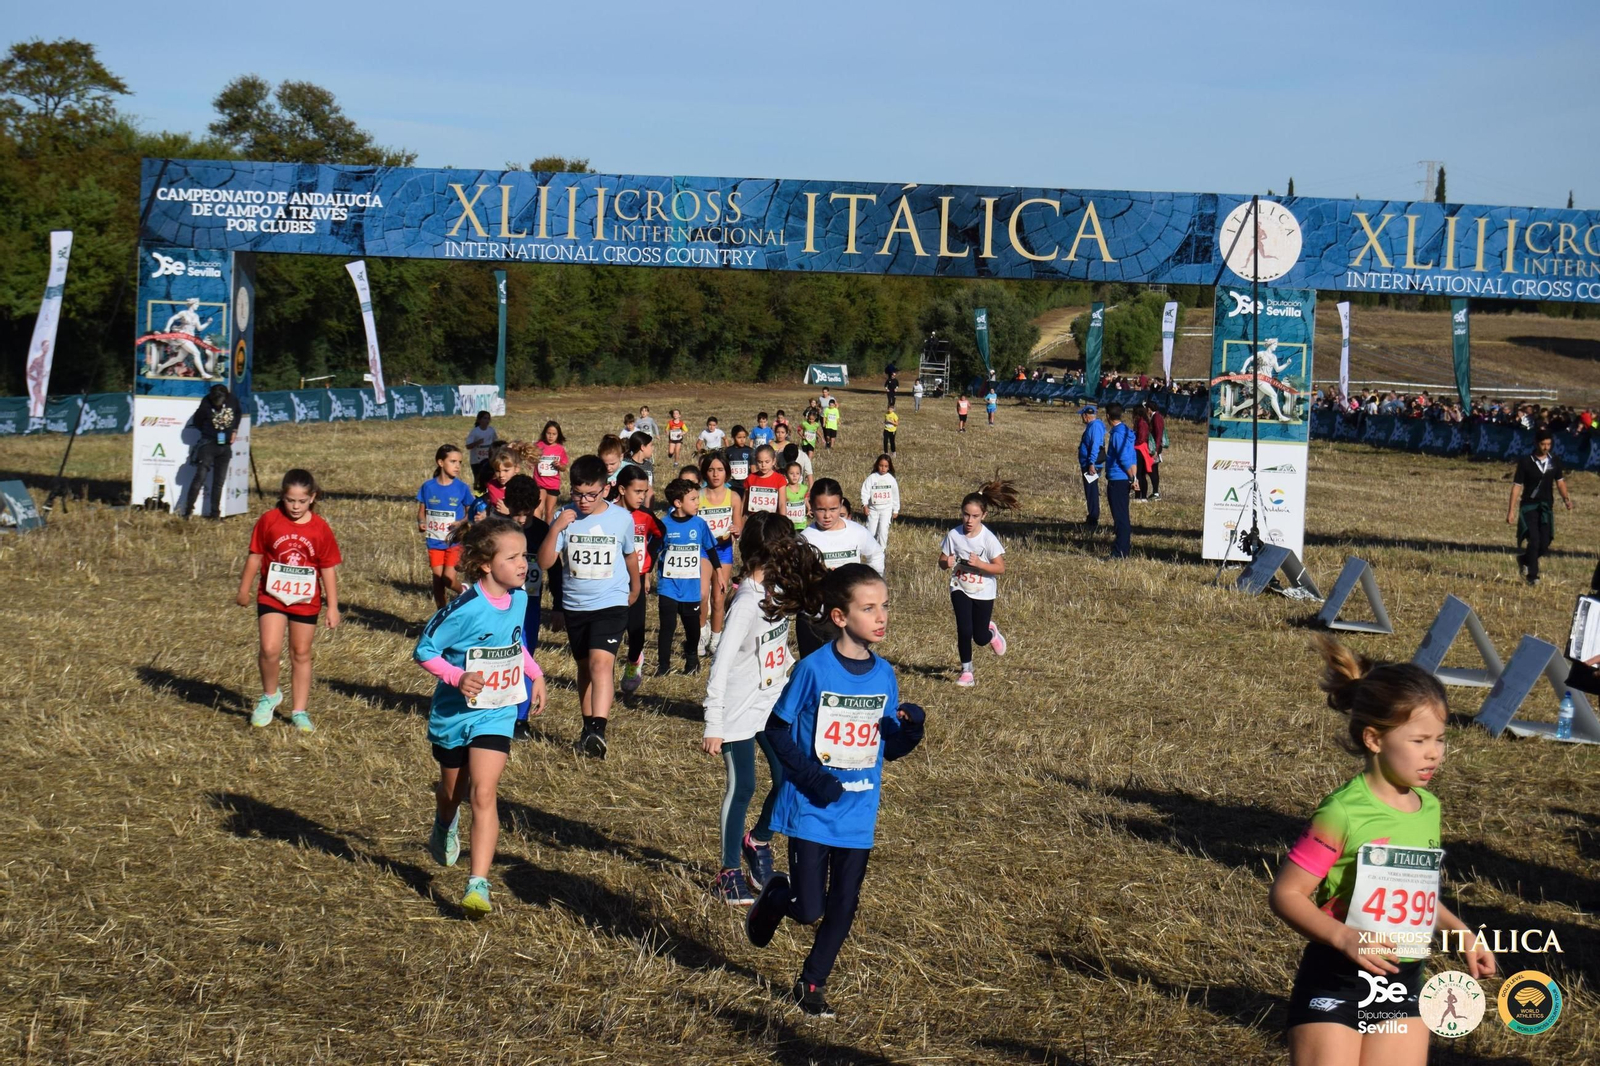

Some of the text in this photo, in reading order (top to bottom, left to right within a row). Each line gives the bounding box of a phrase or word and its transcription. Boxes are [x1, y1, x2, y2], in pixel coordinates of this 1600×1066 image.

[156, 187, 383, 208] CAMPEONATO DE ANDALUCÍA
[191, 203, 348, 221] DE CAMPO A TRAVÉS
[445, 184, 743, 241] XLIII CROSS
[226, 219, 316, 234] POR CLUBES
[800, 182, 1118, 263] ITÁLICA
[613, 224, 789, 247] INTERNACIONAL
[1349, 212, 1519, 273] XLIII
[444, 241, 757, 266] INTERNATIONAL CROSS COUNTRY
[187, 259, 221, 268] Diputación
[187, 267, 221, 278] Sevilla
[1346, 271, 1507, 295] INTERNATIONAL
[1512, 279, 1572, 297] CROSS
[1266, 298, 1302, 307] Diputación
[1266, 307, 1302, 317] Sevilla
[731, 467, 747, 475] 4533
[751, 496, 777, 506] 4534
[873, 491, 891, 499] 4431
[572, 550, 613, 566] 4311
[667, 556, 698, 568] 4159
[955, 569, 983, 585] 4551
[271, 580, 312, 596] 4412
[487, 648, 515, 659] ITÁLICA
[844, 697, 876, 708] ITÁLICA
[823, 720, 880, 747] 4392
[1393, 851, 1432, 867] ITÁLICA
[1361, 887, 1436, 926] 4399
